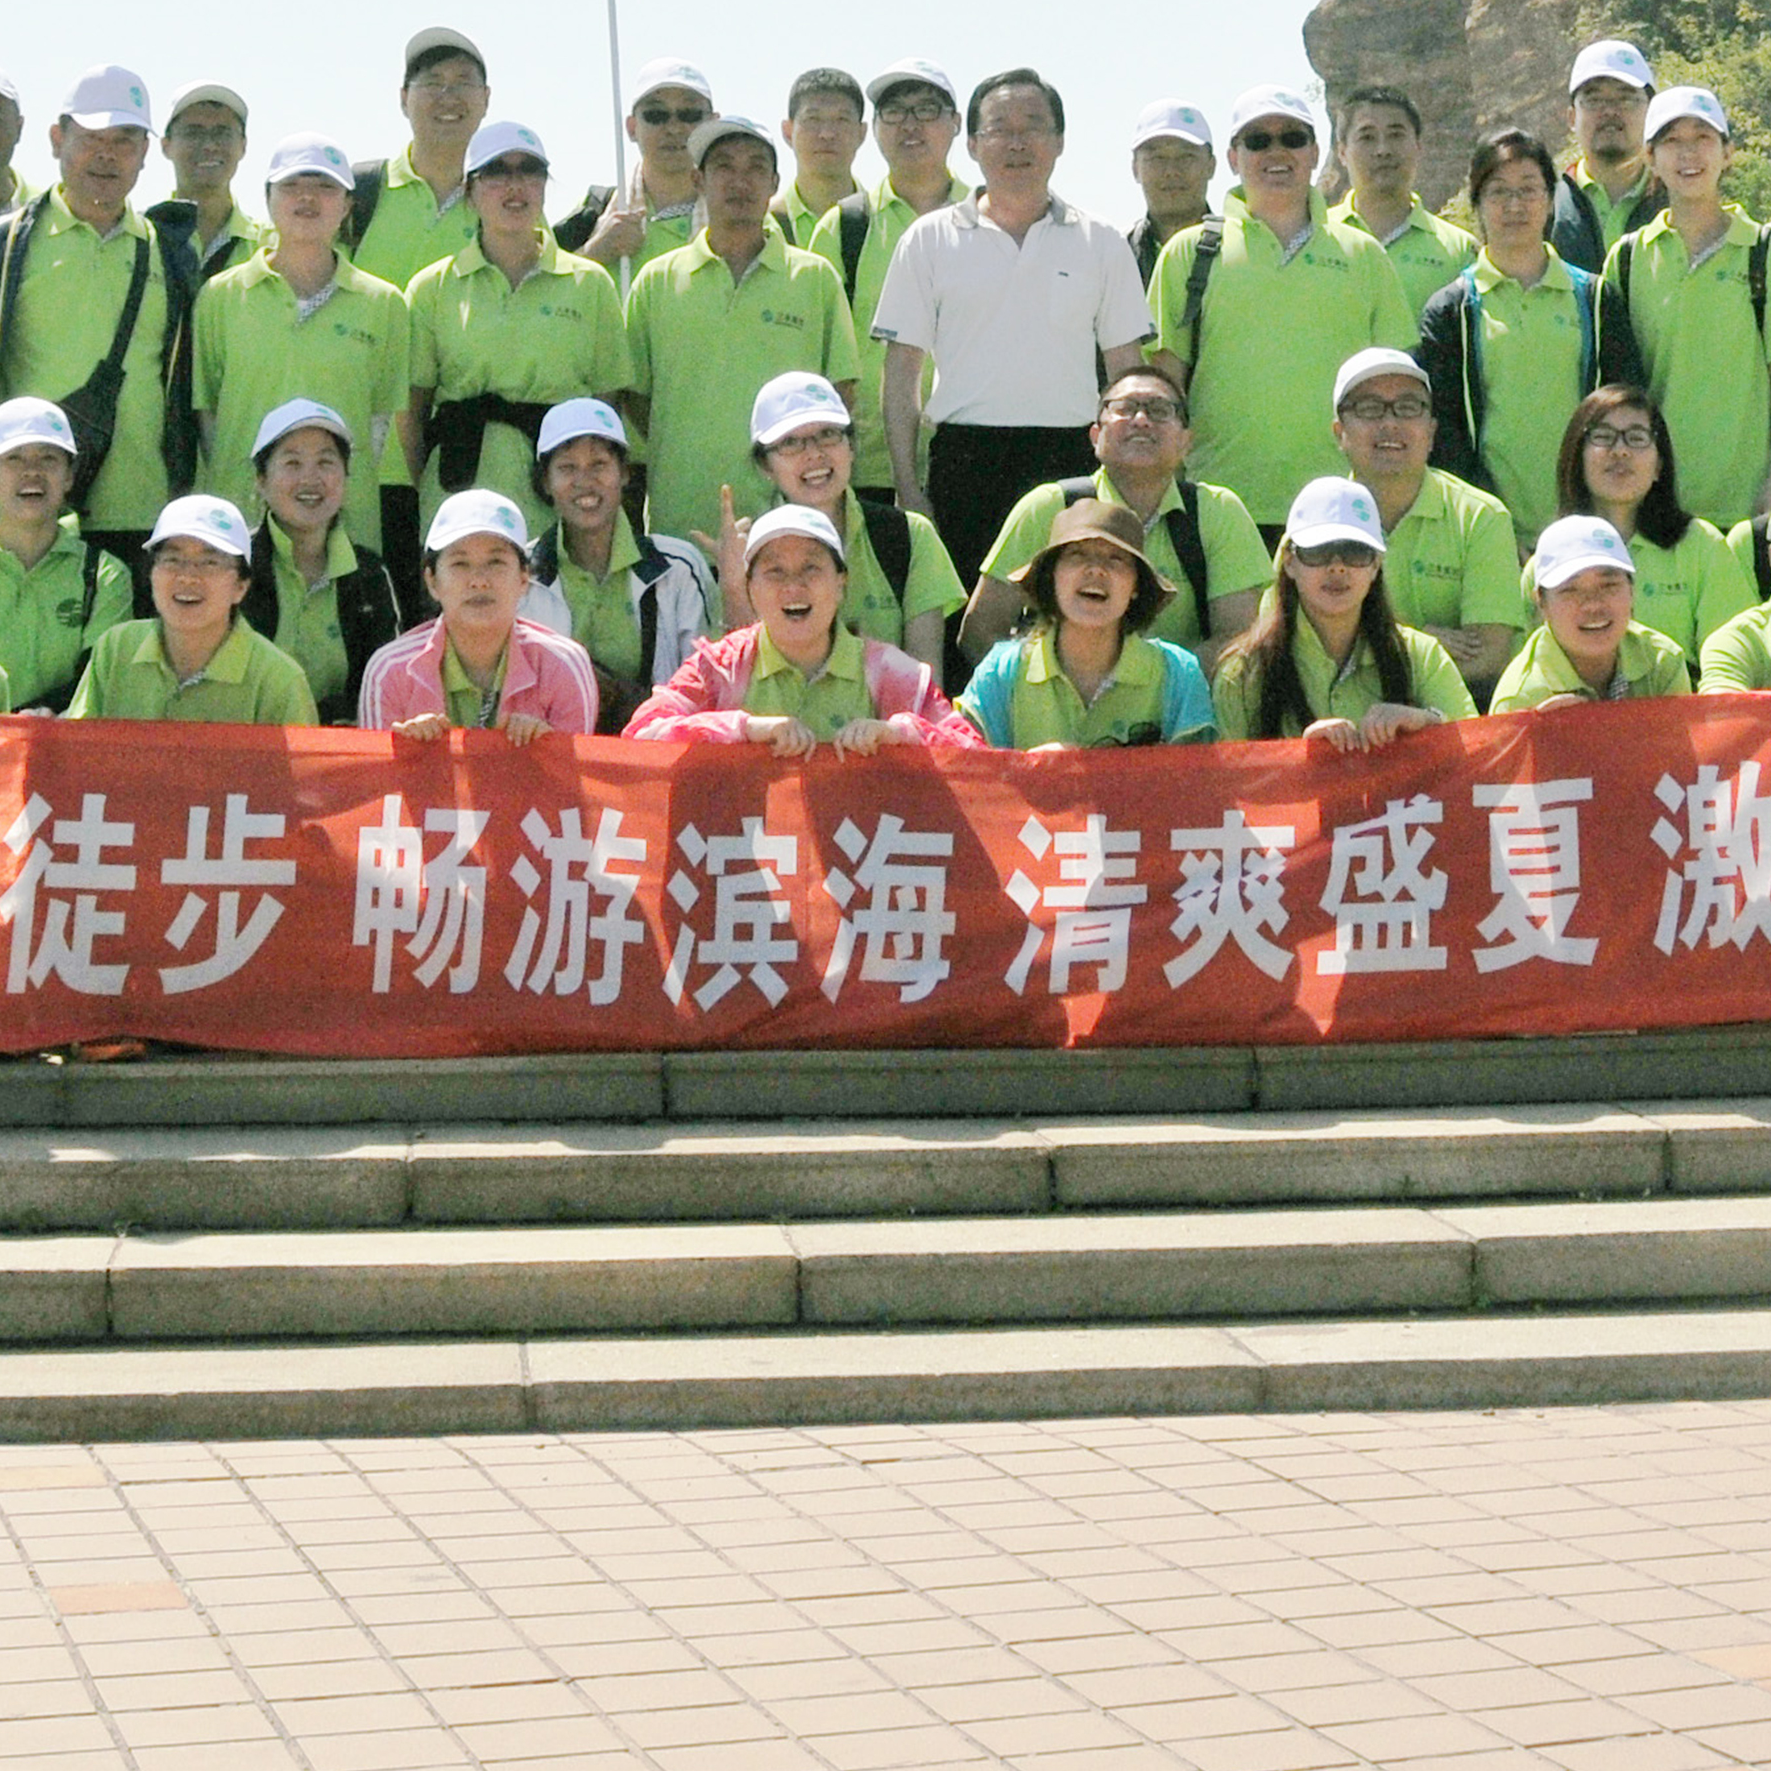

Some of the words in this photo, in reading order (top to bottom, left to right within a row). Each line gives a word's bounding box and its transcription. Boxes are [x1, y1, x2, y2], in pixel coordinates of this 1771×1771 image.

[353, 793, 956, 1012] 畅游滨海
[1003, 792, 1599, 996] 清爽盛夏
